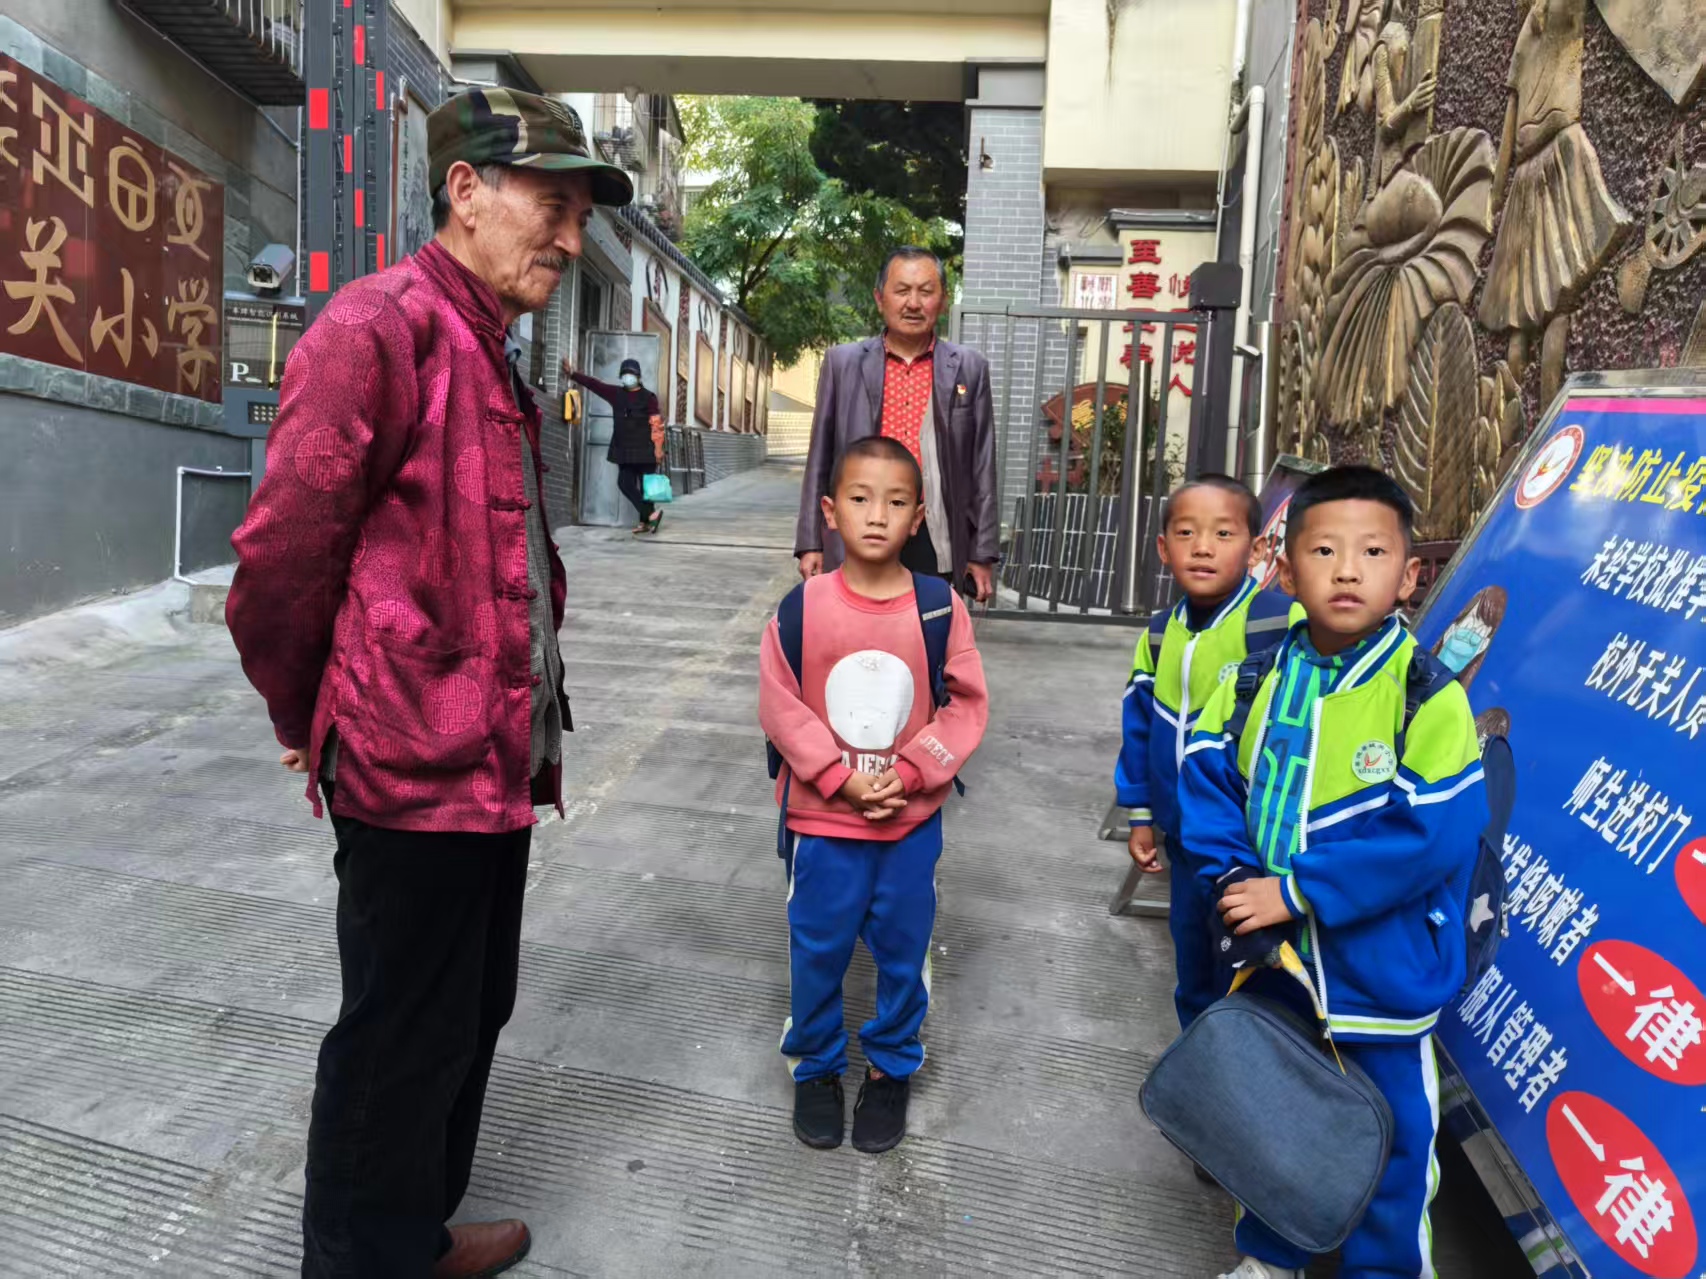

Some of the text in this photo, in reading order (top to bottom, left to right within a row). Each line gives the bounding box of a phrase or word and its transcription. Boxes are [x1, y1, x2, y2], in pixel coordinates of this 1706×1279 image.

[4, 216, 218, 391] 关小学
[230, 362, 249, 382] P
[1569, 444, 1706, 514] 坚决防止疫
[1562, 756, 1693, 875] 师生进校门
[1457, 963, 1568, 1115] 服从管理者
[1593, 951, 1705, 1072] 一律
[1561, 1103, 1675, 1259] 一律
